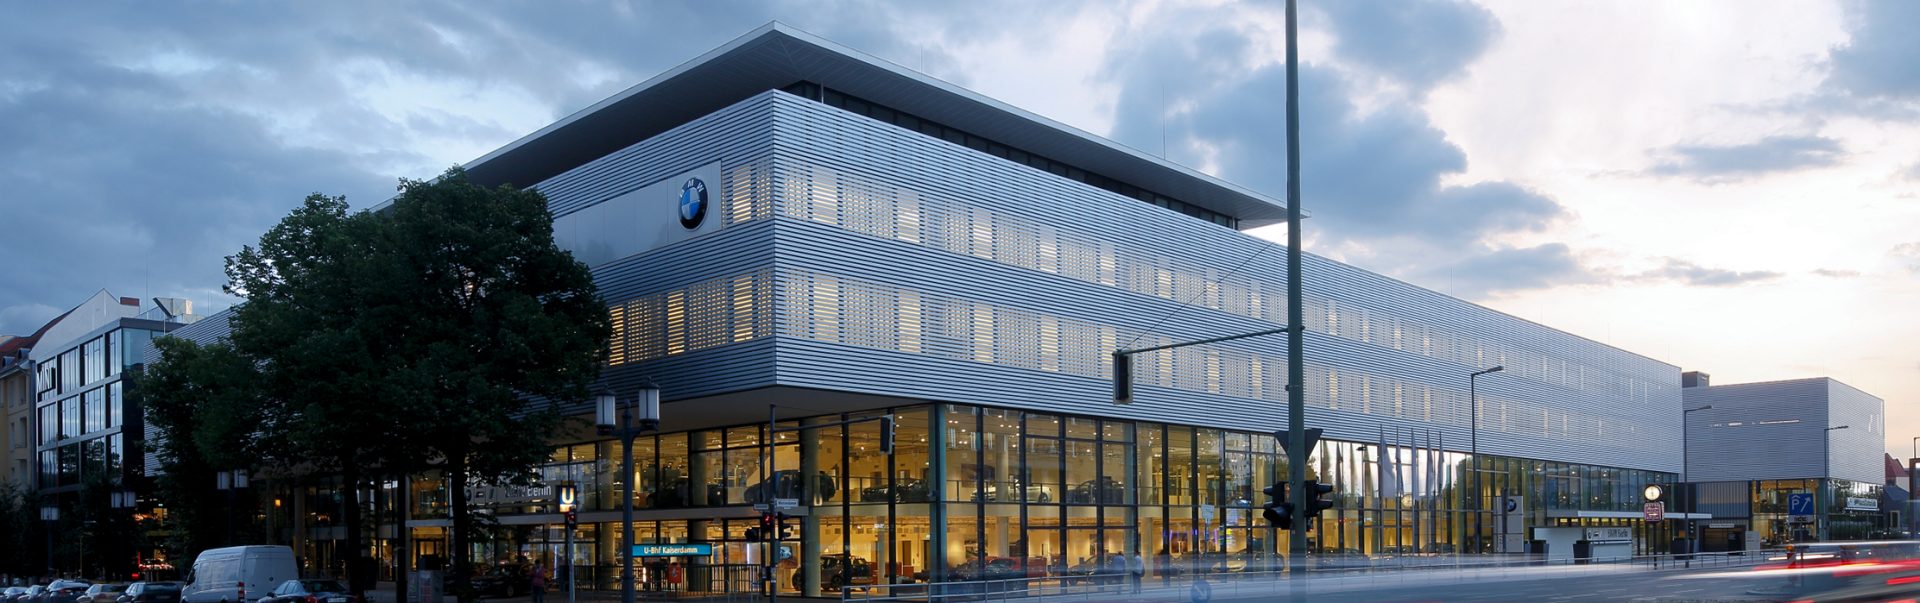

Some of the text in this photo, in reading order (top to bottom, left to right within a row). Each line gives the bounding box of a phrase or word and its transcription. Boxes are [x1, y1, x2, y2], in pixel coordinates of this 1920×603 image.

[680, 179, 704, 198] BMW
[562, 487, 575, 504] U
[1791, 498, 1800, 511] P
[643, 546, 698, 555] U-Bhf Kaiserdamm
